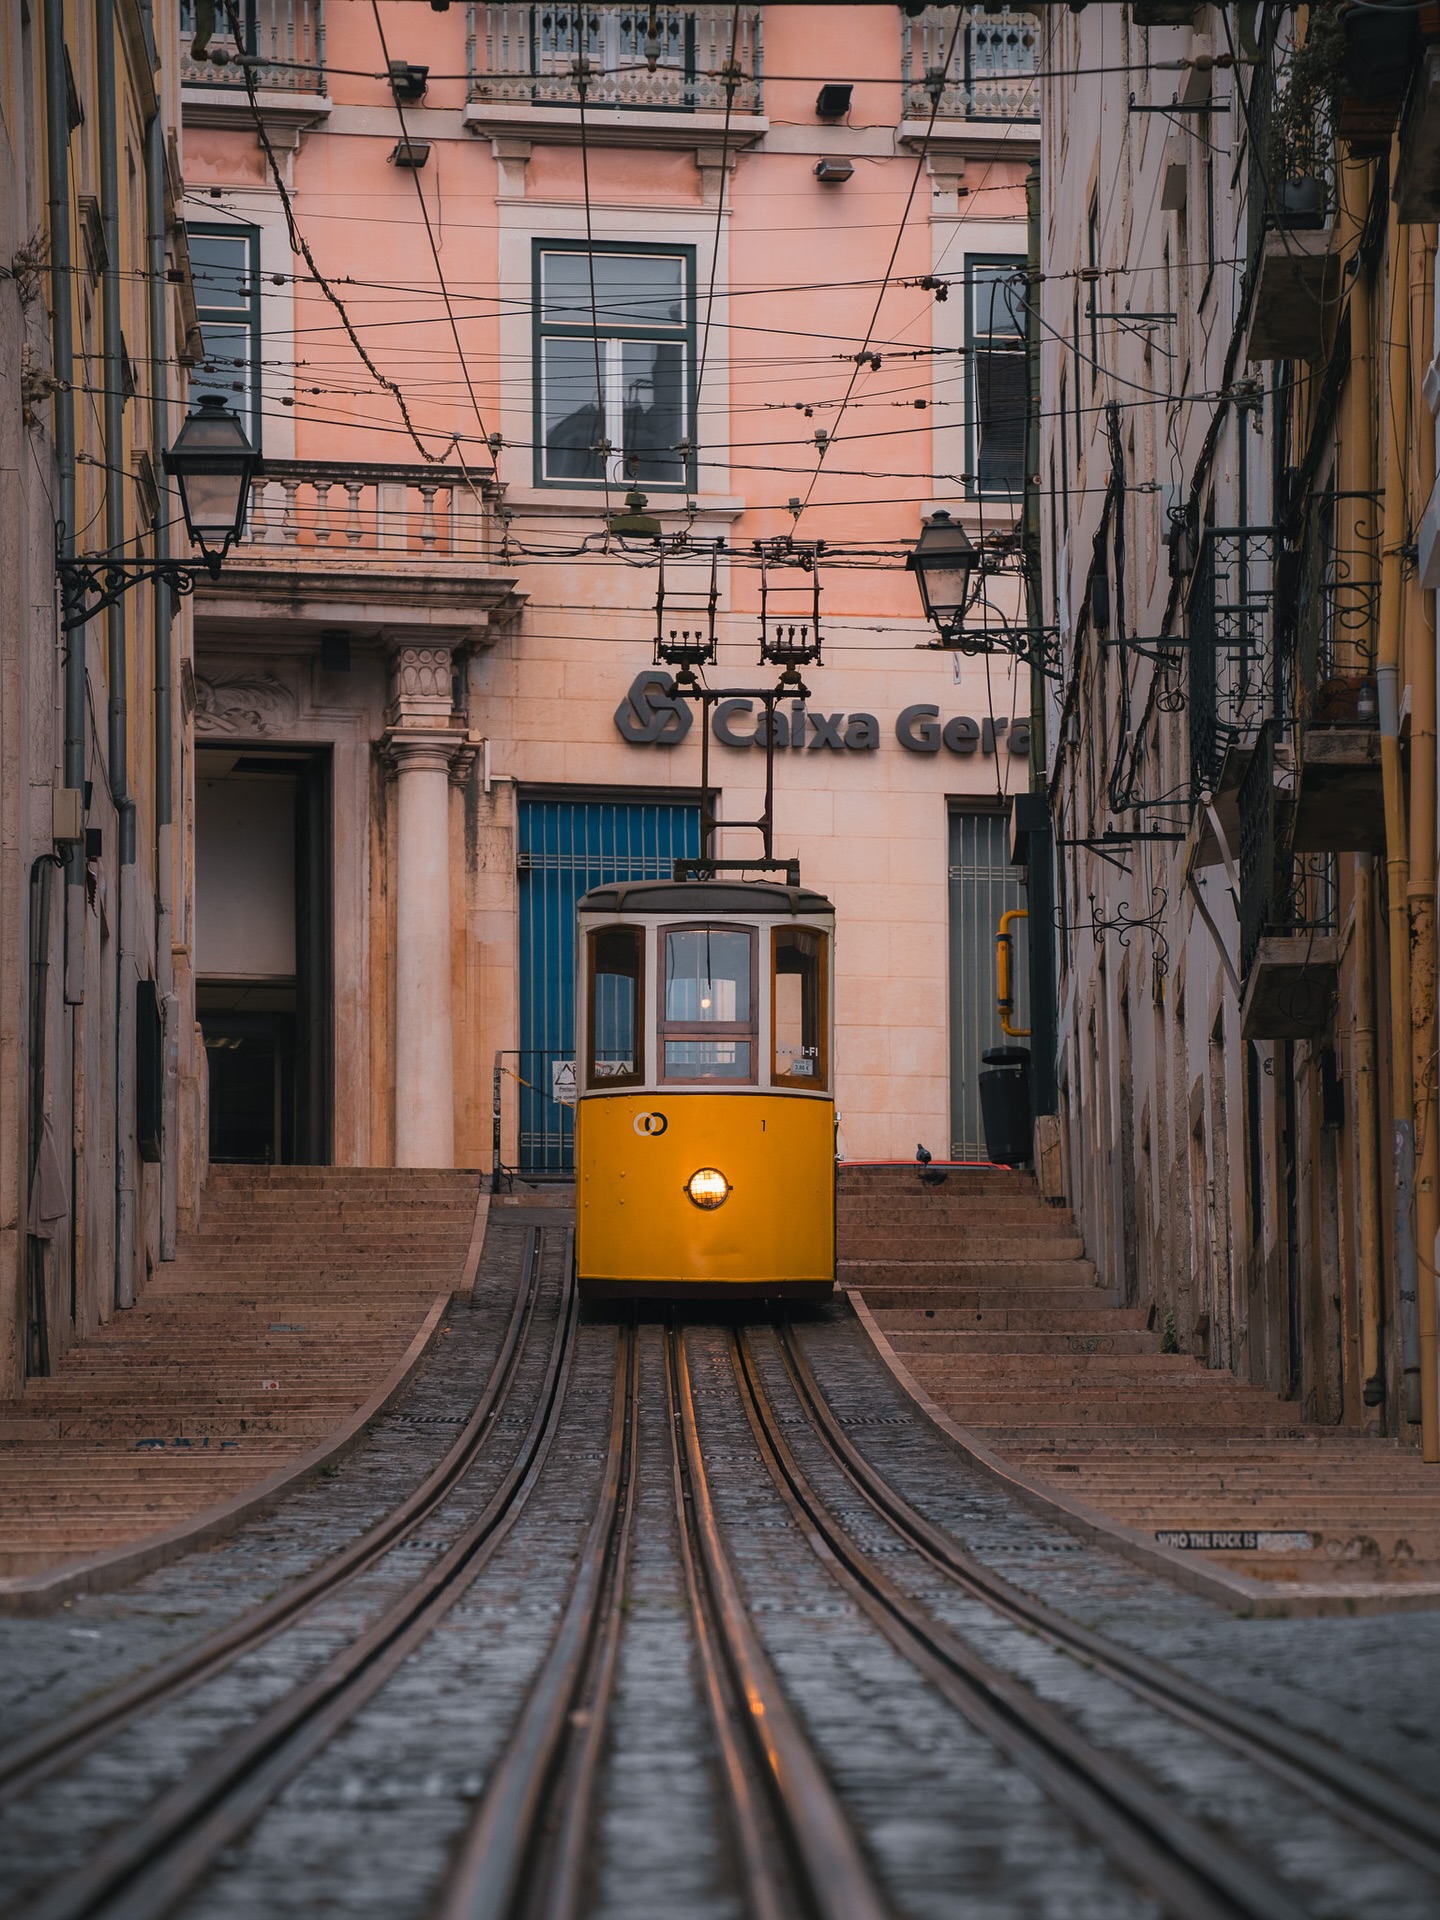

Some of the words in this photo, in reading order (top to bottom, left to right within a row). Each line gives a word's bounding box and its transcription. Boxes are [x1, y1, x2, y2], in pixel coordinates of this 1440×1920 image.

[712, 699, 880, 750] Caixa
[797, 1045, 818, 1057] I-FI
[761, 1119, 765, 1132] 1
[1157, 1532, 1188, 1548] WHO
[1189, 1532, 1211, 1548] THE
[1212, 1532, 1242, 1548] FUCK
[1243, 1532, 1256, 1548] IS
